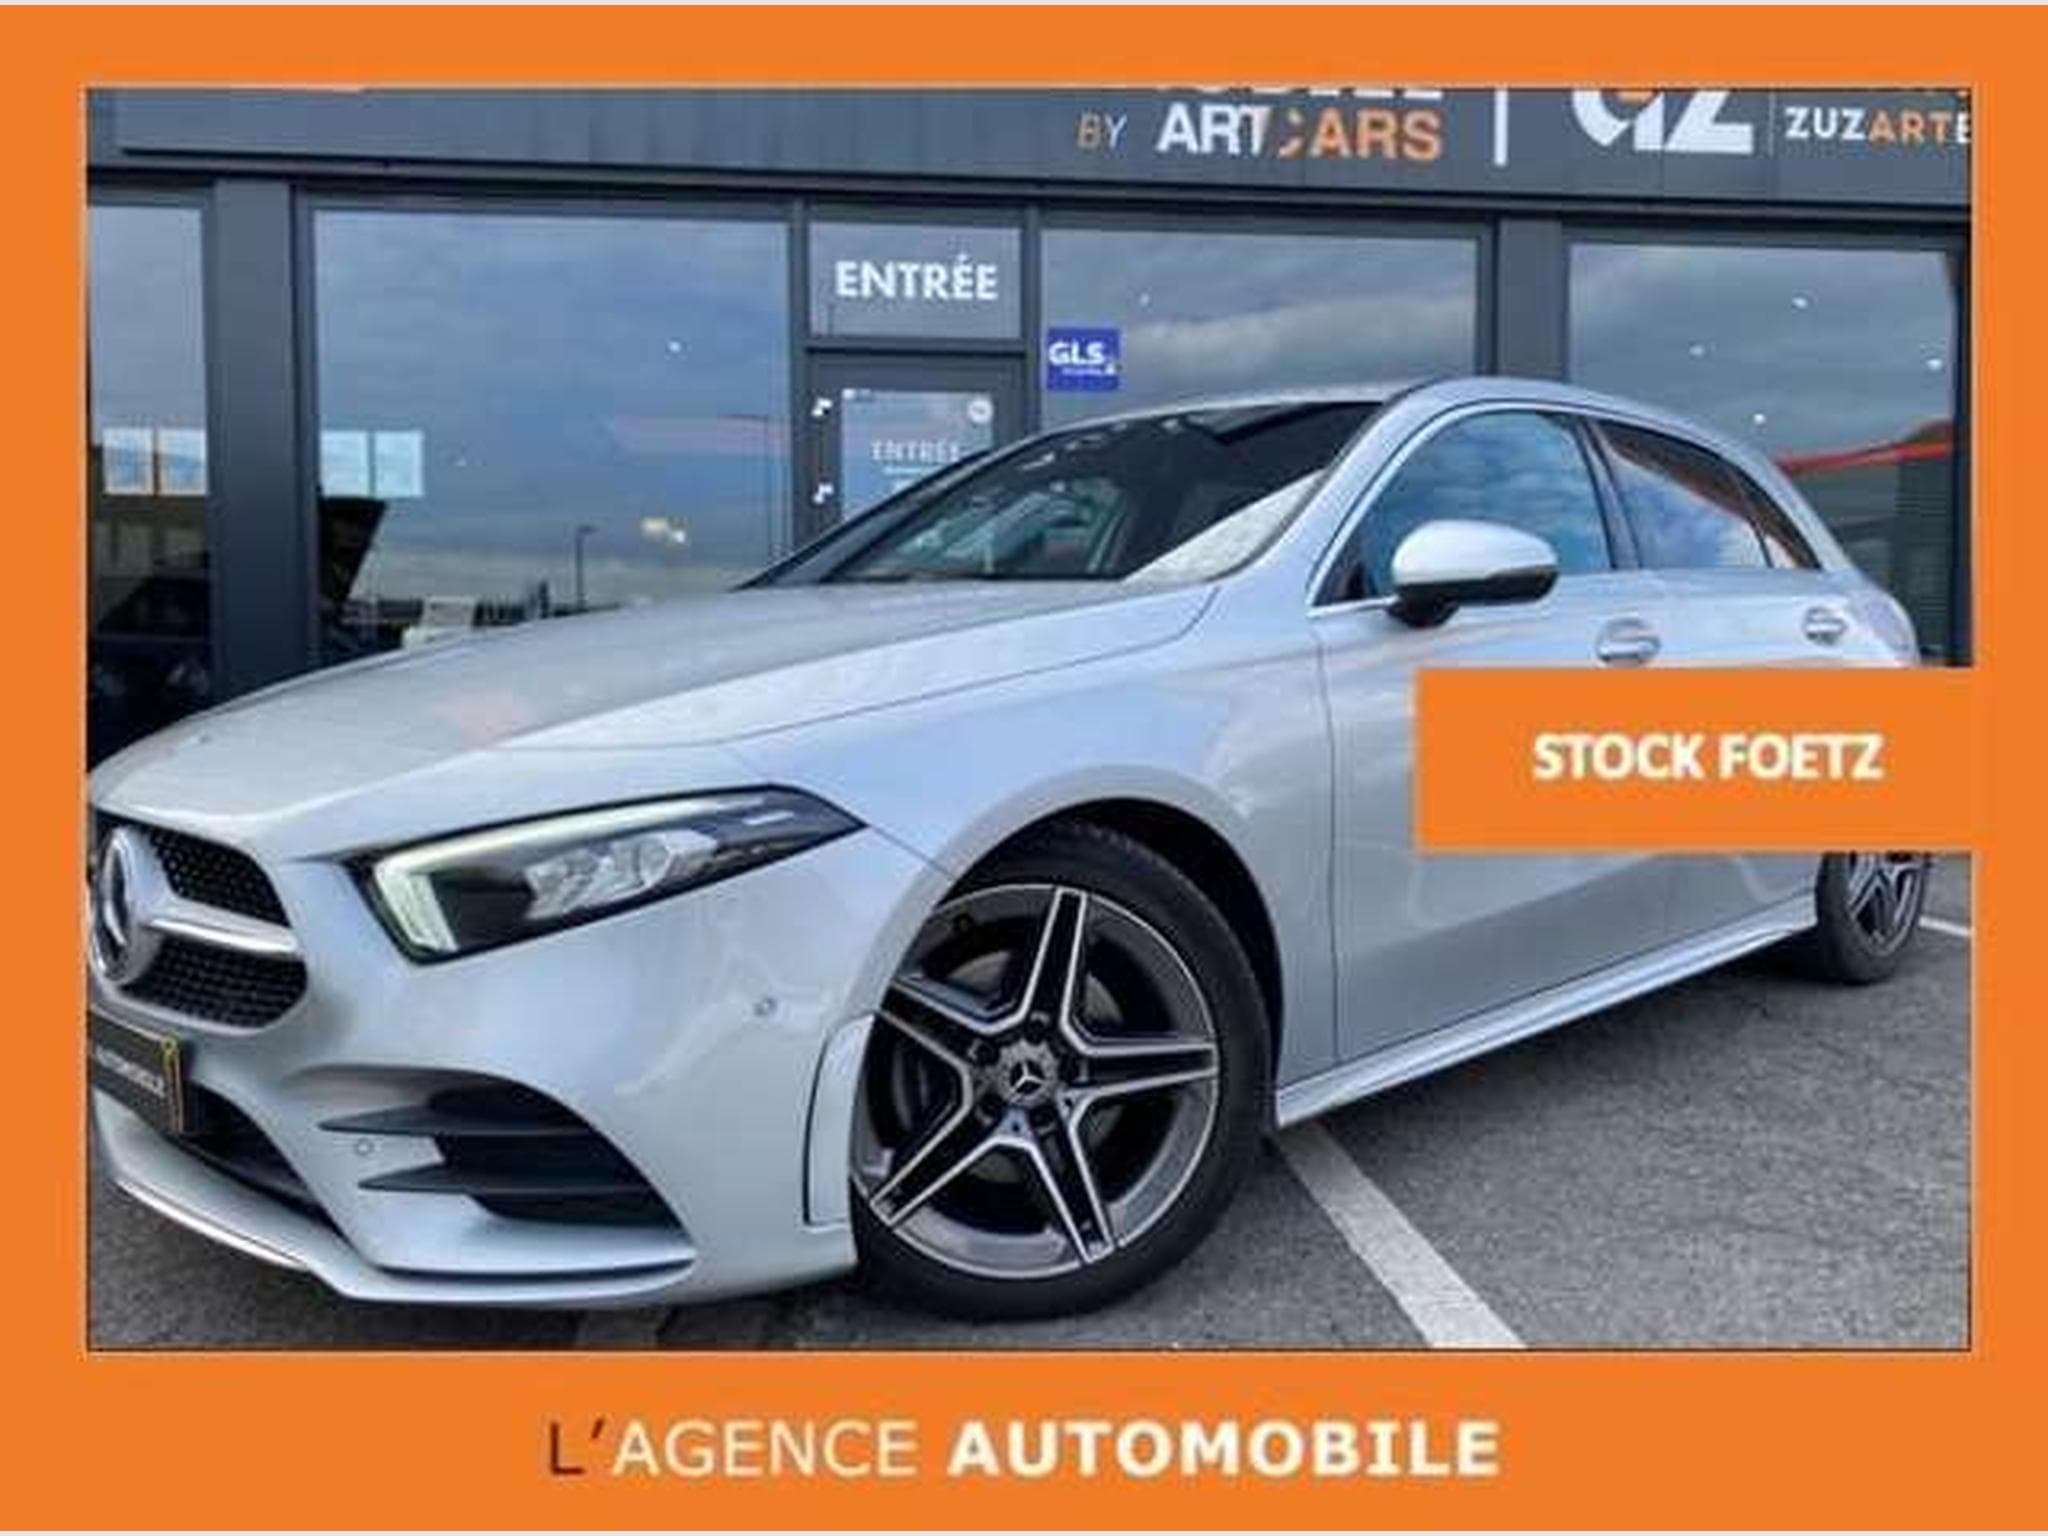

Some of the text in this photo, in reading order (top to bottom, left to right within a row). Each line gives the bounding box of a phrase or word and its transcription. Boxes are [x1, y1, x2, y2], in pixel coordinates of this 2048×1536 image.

[1076, 112, 1128, 149] BY
[834, 252, 999, 300] ENTRÉE
[1049, 341, 1105, 366] GLS
